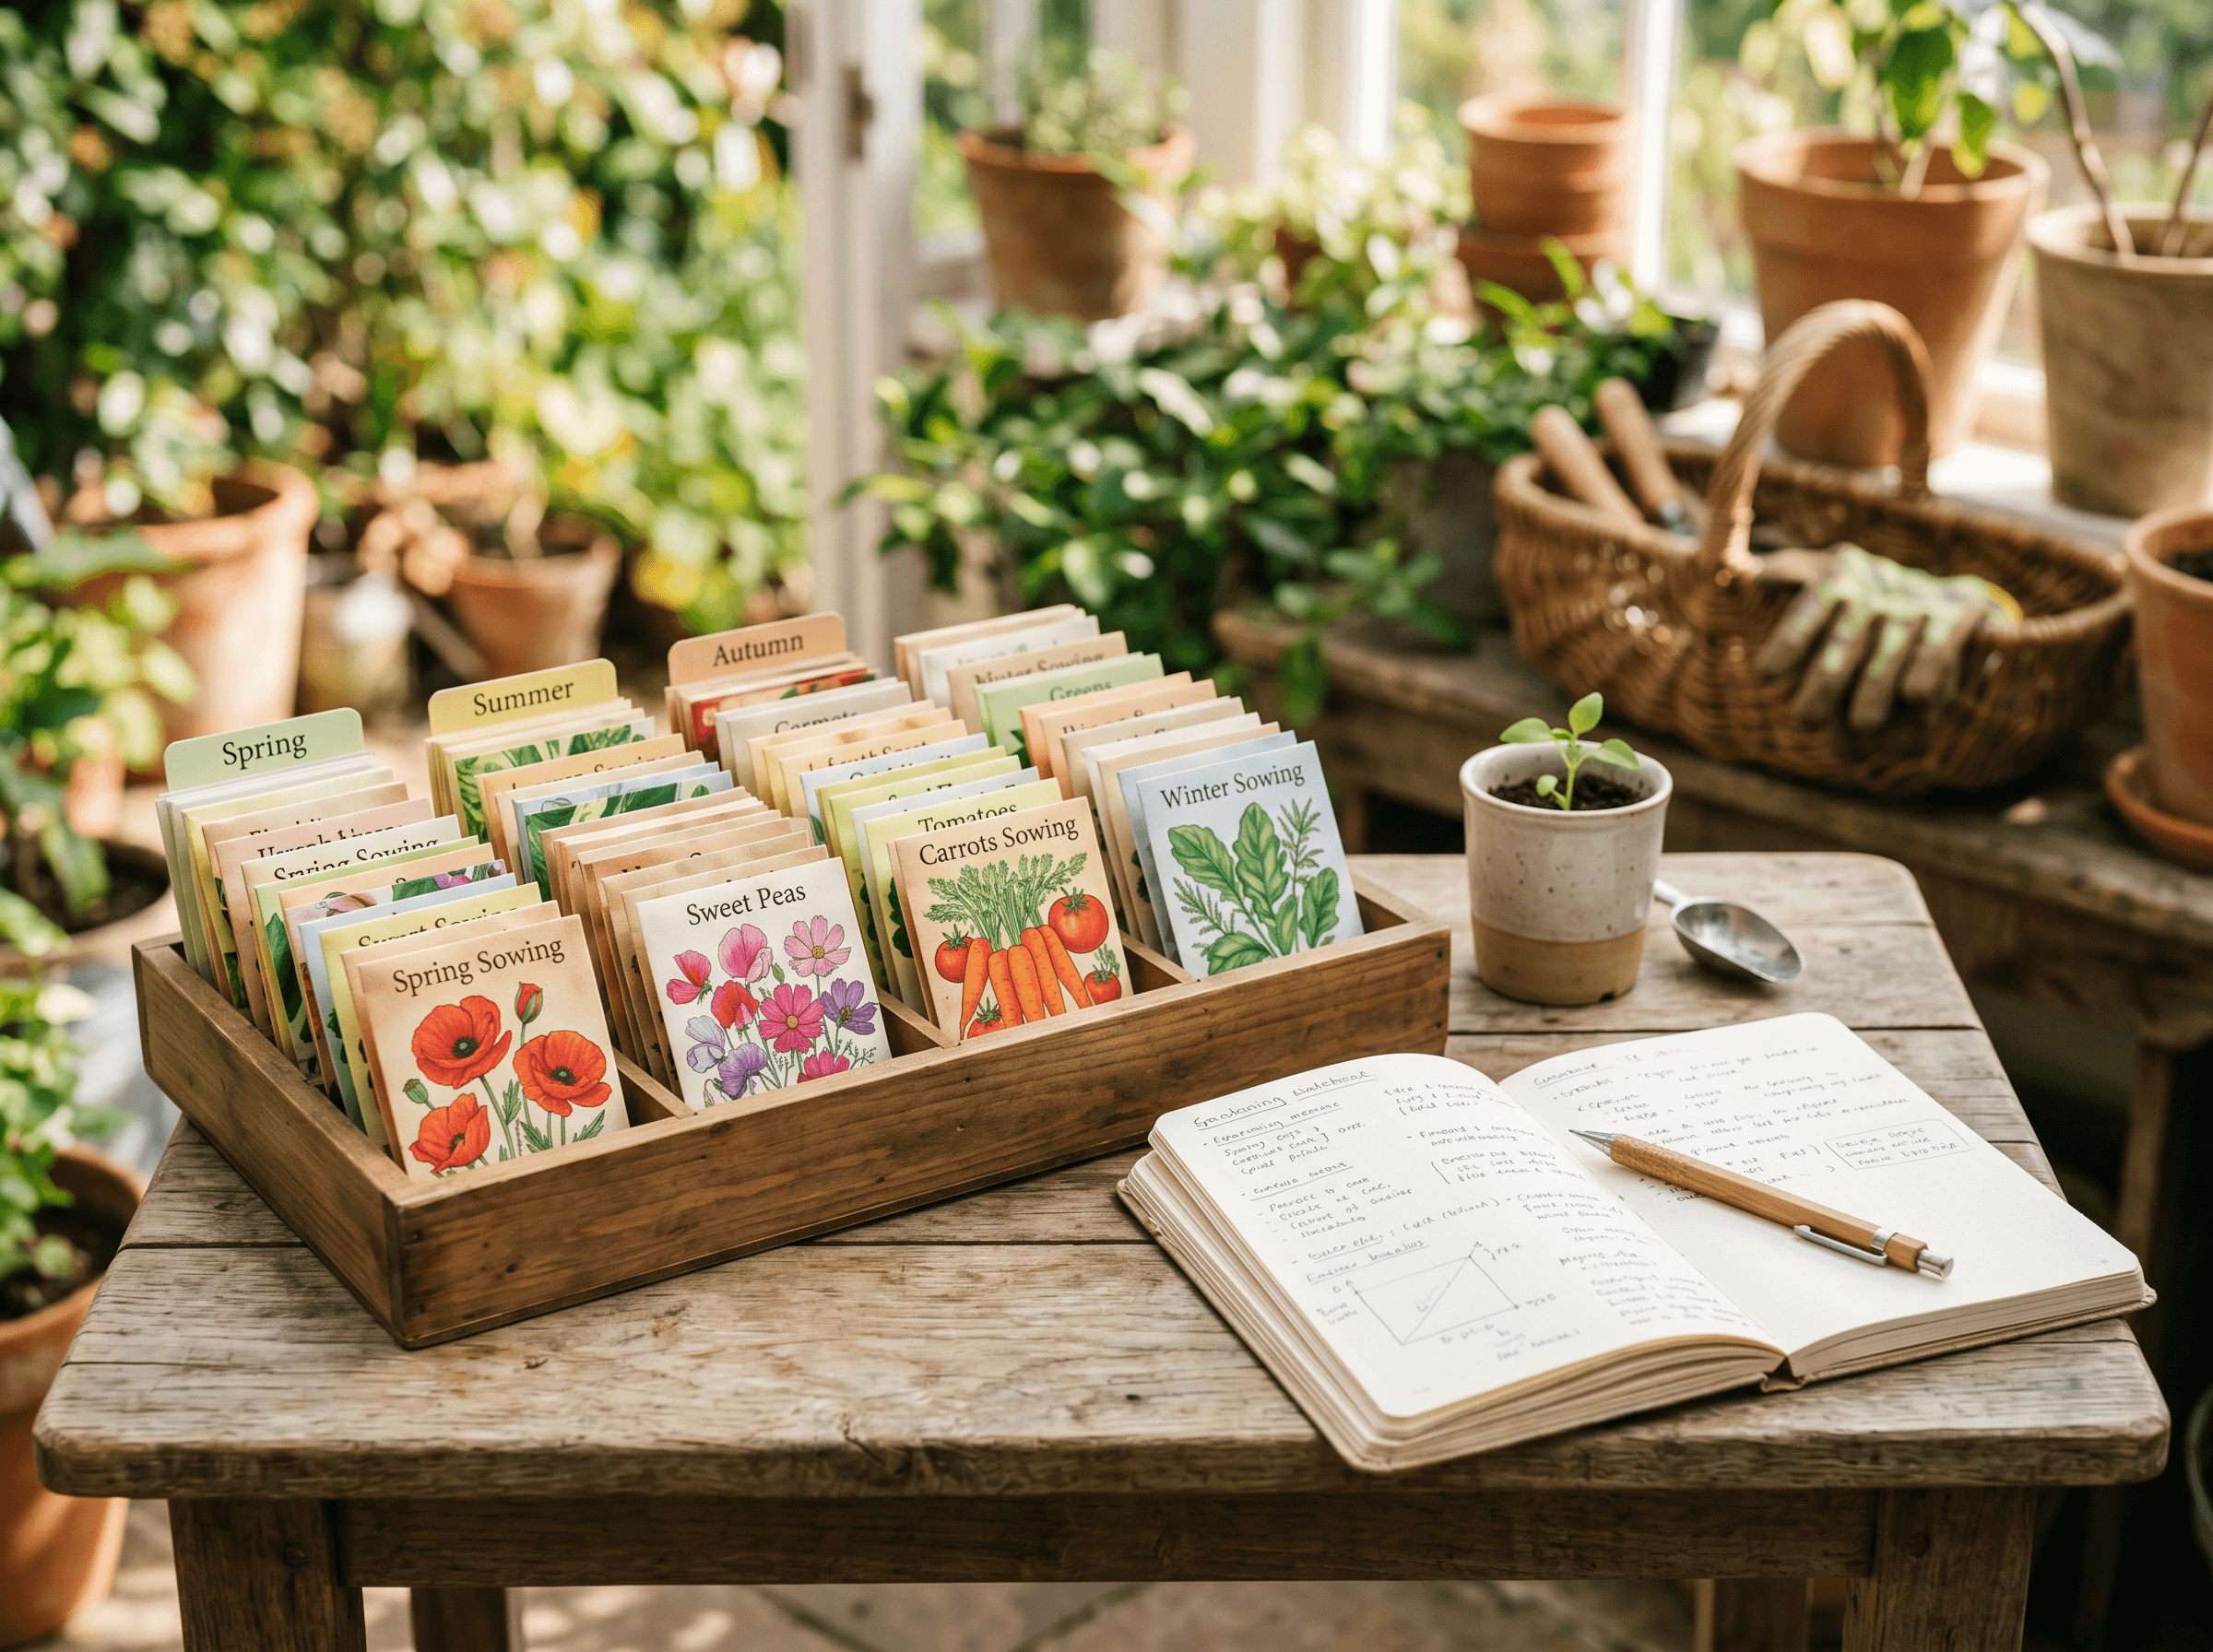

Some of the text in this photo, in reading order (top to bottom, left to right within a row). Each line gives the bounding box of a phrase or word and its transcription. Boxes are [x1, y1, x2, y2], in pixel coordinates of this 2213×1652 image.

[713, 634, 804, 667] Autumn
[473, 682, 574, 716] Summer
[222, 734, 307, 771] Spring
[1159, 765, 1306, 809] Winter Sowing
[917, 804, 1018, 832] Tomatoes
[919, 819, 1079, 866] Carrots Sowing
[686, 885, 806, 926] Sweet Peas
[392, 939, 565, 997] Spring Sowing
